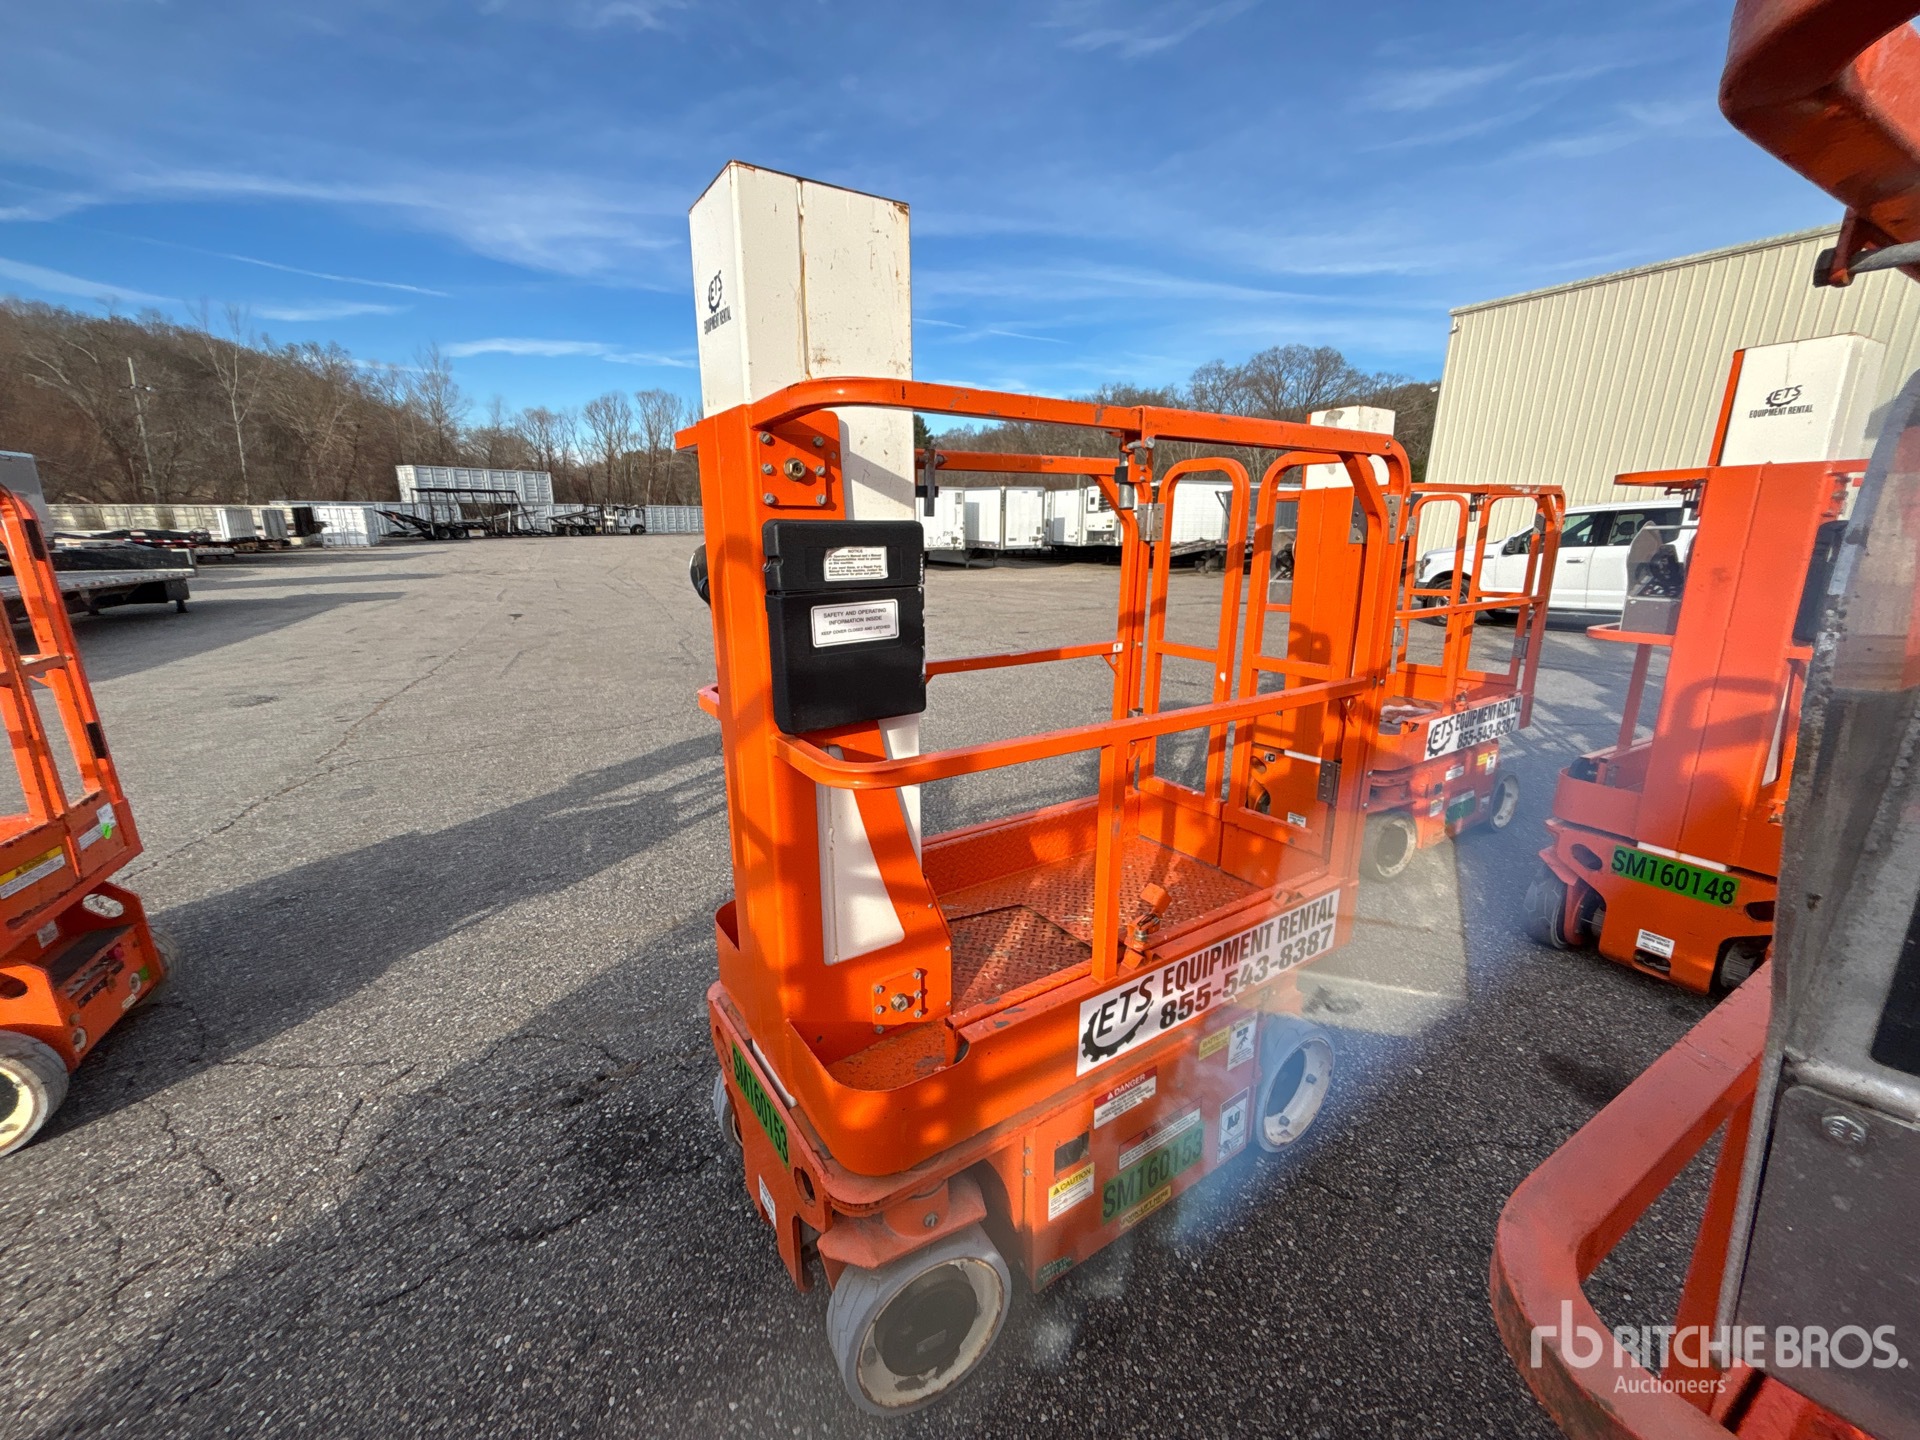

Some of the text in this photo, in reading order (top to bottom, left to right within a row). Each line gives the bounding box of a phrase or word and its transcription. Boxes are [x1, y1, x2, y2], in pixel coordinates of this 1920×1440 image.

[1772, 384, 1803, 401] ETS
[1749, 404, 1813, 418] EQUIPMENT RENTAL
[829, 617, 864, 626] INFORMATION
[1433, 716, 1455, 744] ETS
[1455, 697, 1521, 731] EQUIPMENT RENTAL
[1457, 717, 1516, 749] 855-543-8387
[1611, 849, 1735, 905] SM160148
[1162, 892, 1335, 998] EQUIPMENT RENTAL
[1159, 924, 1333, 1029] 855-543-8387
[1096, 975, 1154, 1039] ETS
[1114, 1073, 1146, 1096] DANGER
[732, 1046, 788, 1164] SM160153
[1060, 1167, 1091, 1190] CAUTION
[1103, 1127, 1203, 1218] SM160153
